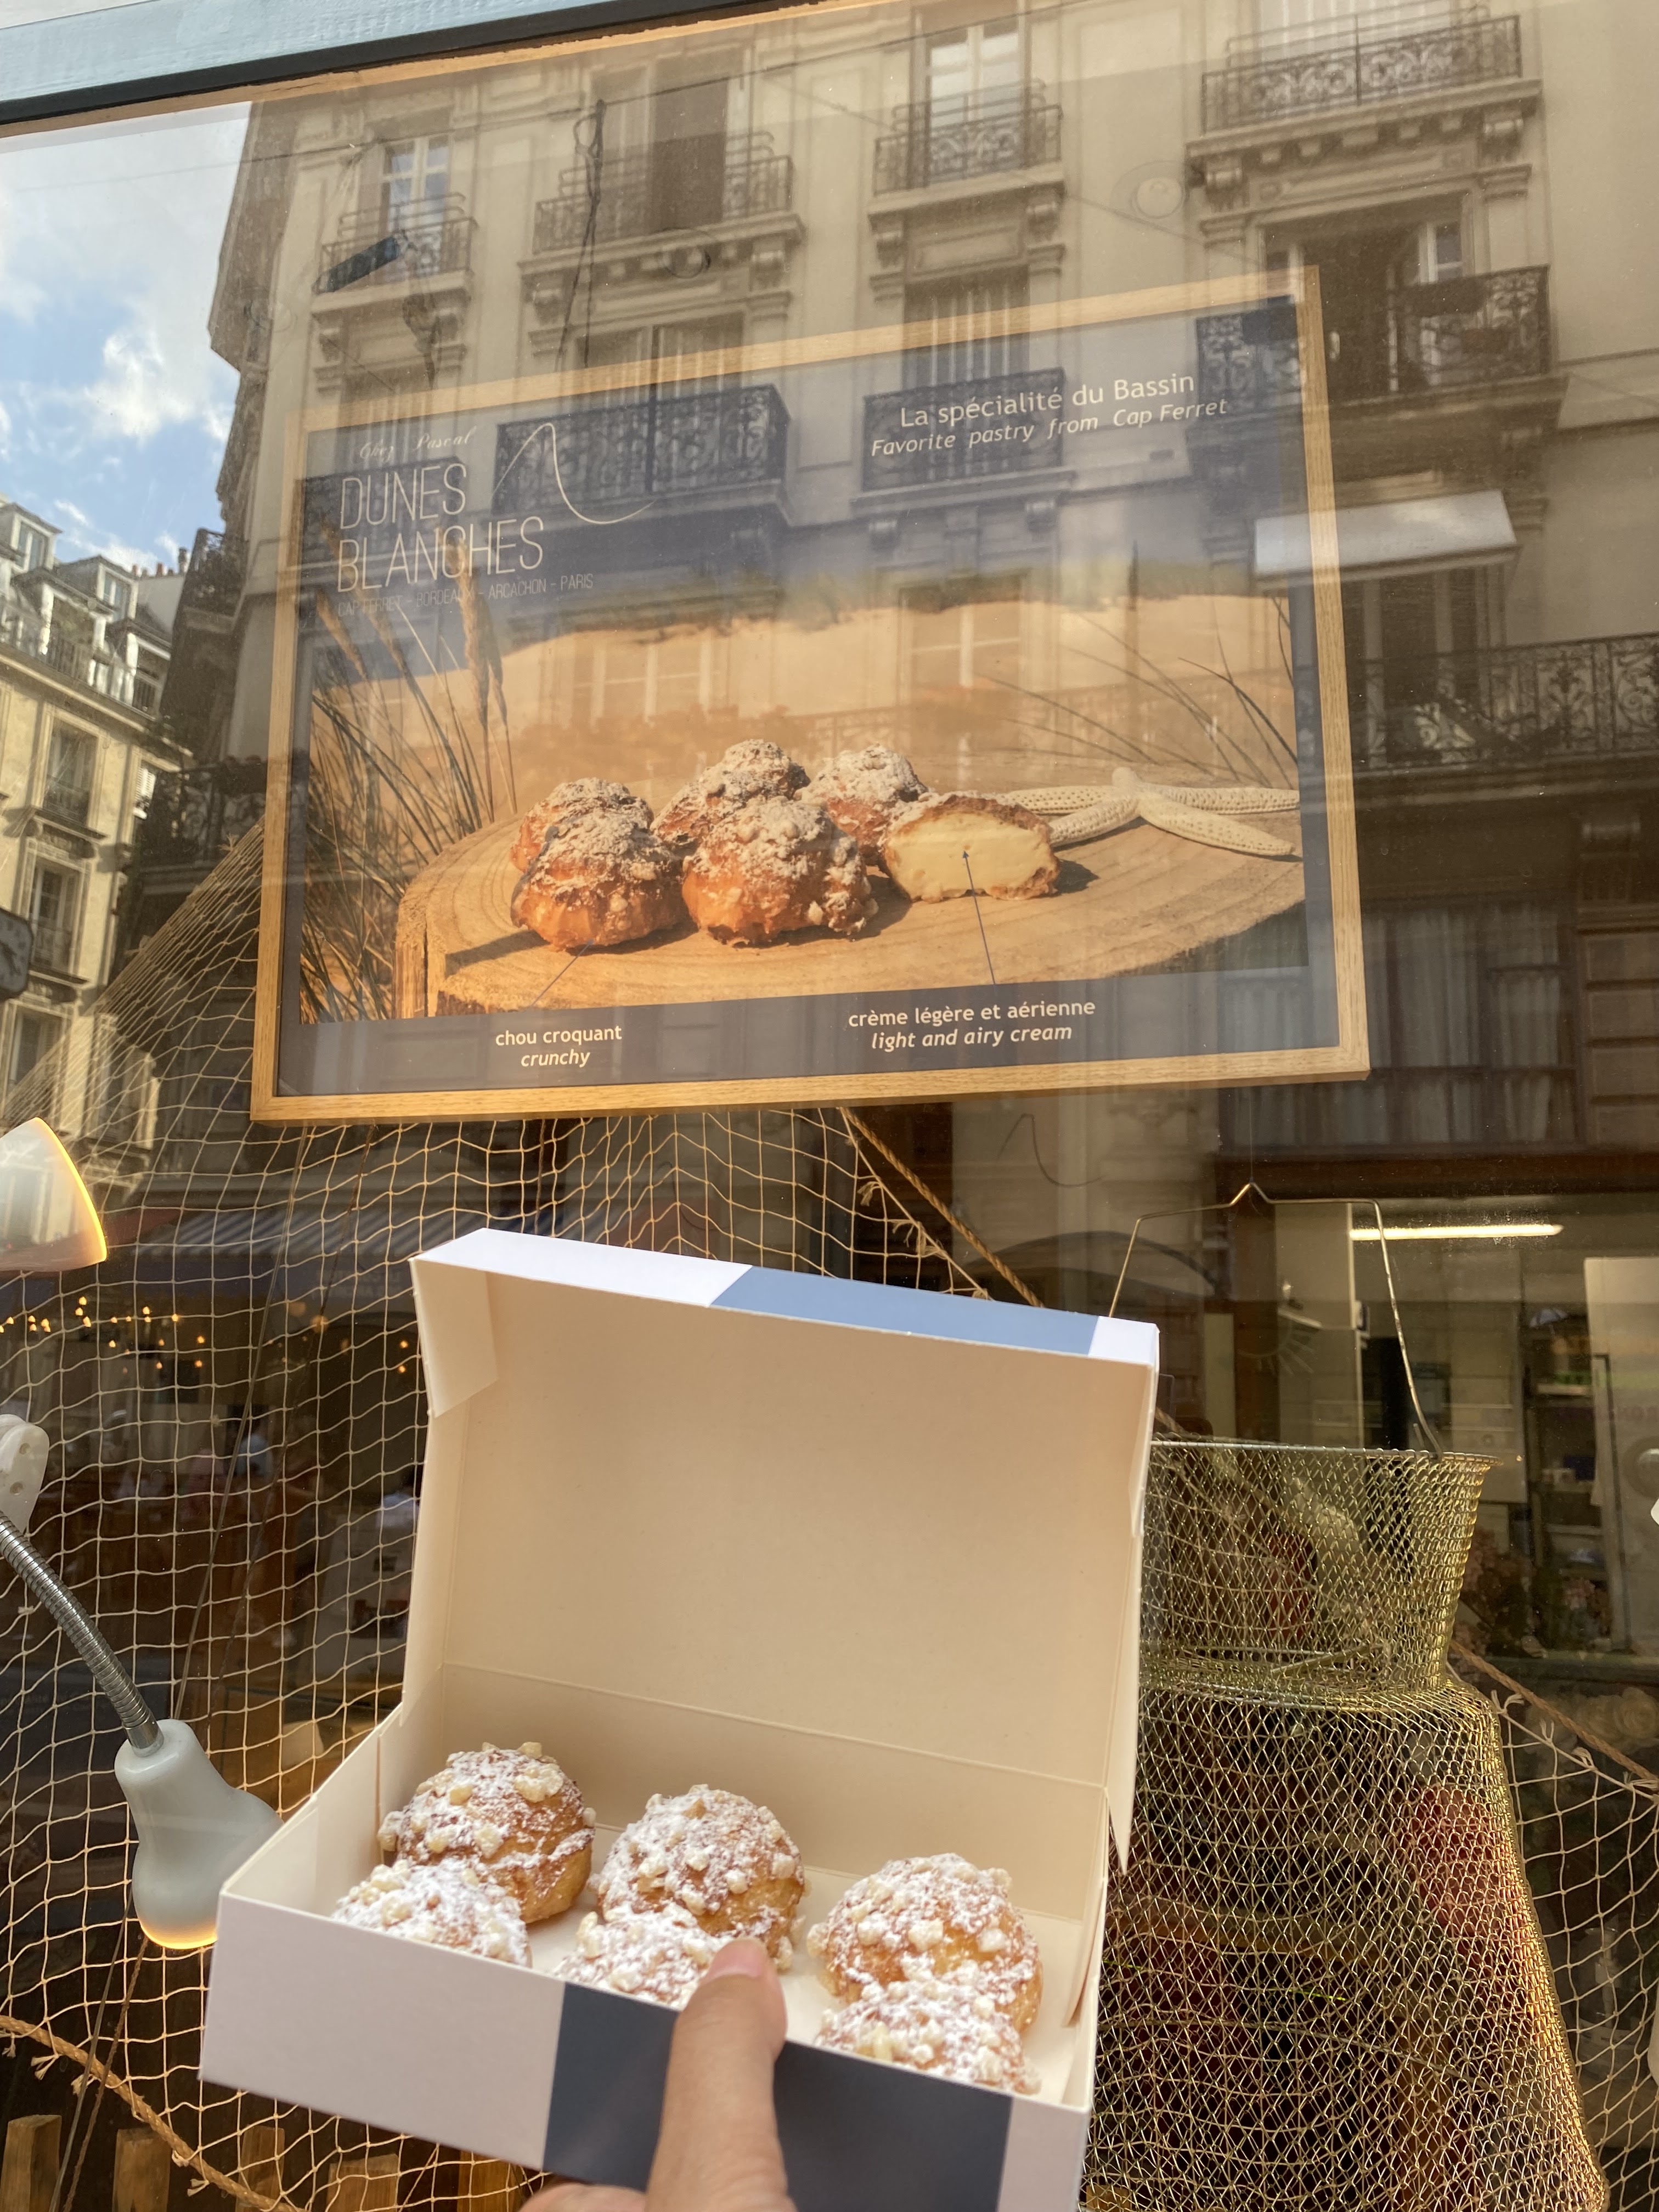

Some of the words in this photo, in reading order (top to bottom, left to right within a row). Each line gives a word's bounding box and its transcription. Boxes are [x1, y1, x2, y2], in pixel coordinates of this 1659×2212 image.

[901, 407, 929, 428] La
[938, 386, 1063, 424] spécialité
[1072, 383, 1104, 406] du
[1114, 373, 1195, 402] Bassin
[871, 433, 956, 456] Favorite
[969, 424, 1035, 449] pastry
[1047, 416, 1098, 440] from
[1113, 408, 1153, 429] Cap
[1160, 398, 1228, 421] Ferret
[340, 462, 467, 529] DUNES
[337, 516, 544, 593] BLANCHES
[337, 600, 359, 618] CAP
[416, 586, 474, 608] BORDEAUX
[488, 578, 547, 600] ARCACHON
[560, 573, 594, 591] PARIS
[495, 1030, 537, 1046] chou
[543, 1025, 623, 1046] croquant
[848, 1009, 909, 1027] crème
[915, 1005, 974, 1027] légère
[980, 1003, 1001, 1020] et
[1007, 1001, 1096, 1019] aérienne
[521, 1048, 591, 1068] crunchy
[872, 1032, 916, 1053] light
[922, 1028, 958, 1047] and
[963, 1026, 1004, 1047] airy
[1010, 1026, 1072, 1042] cream
